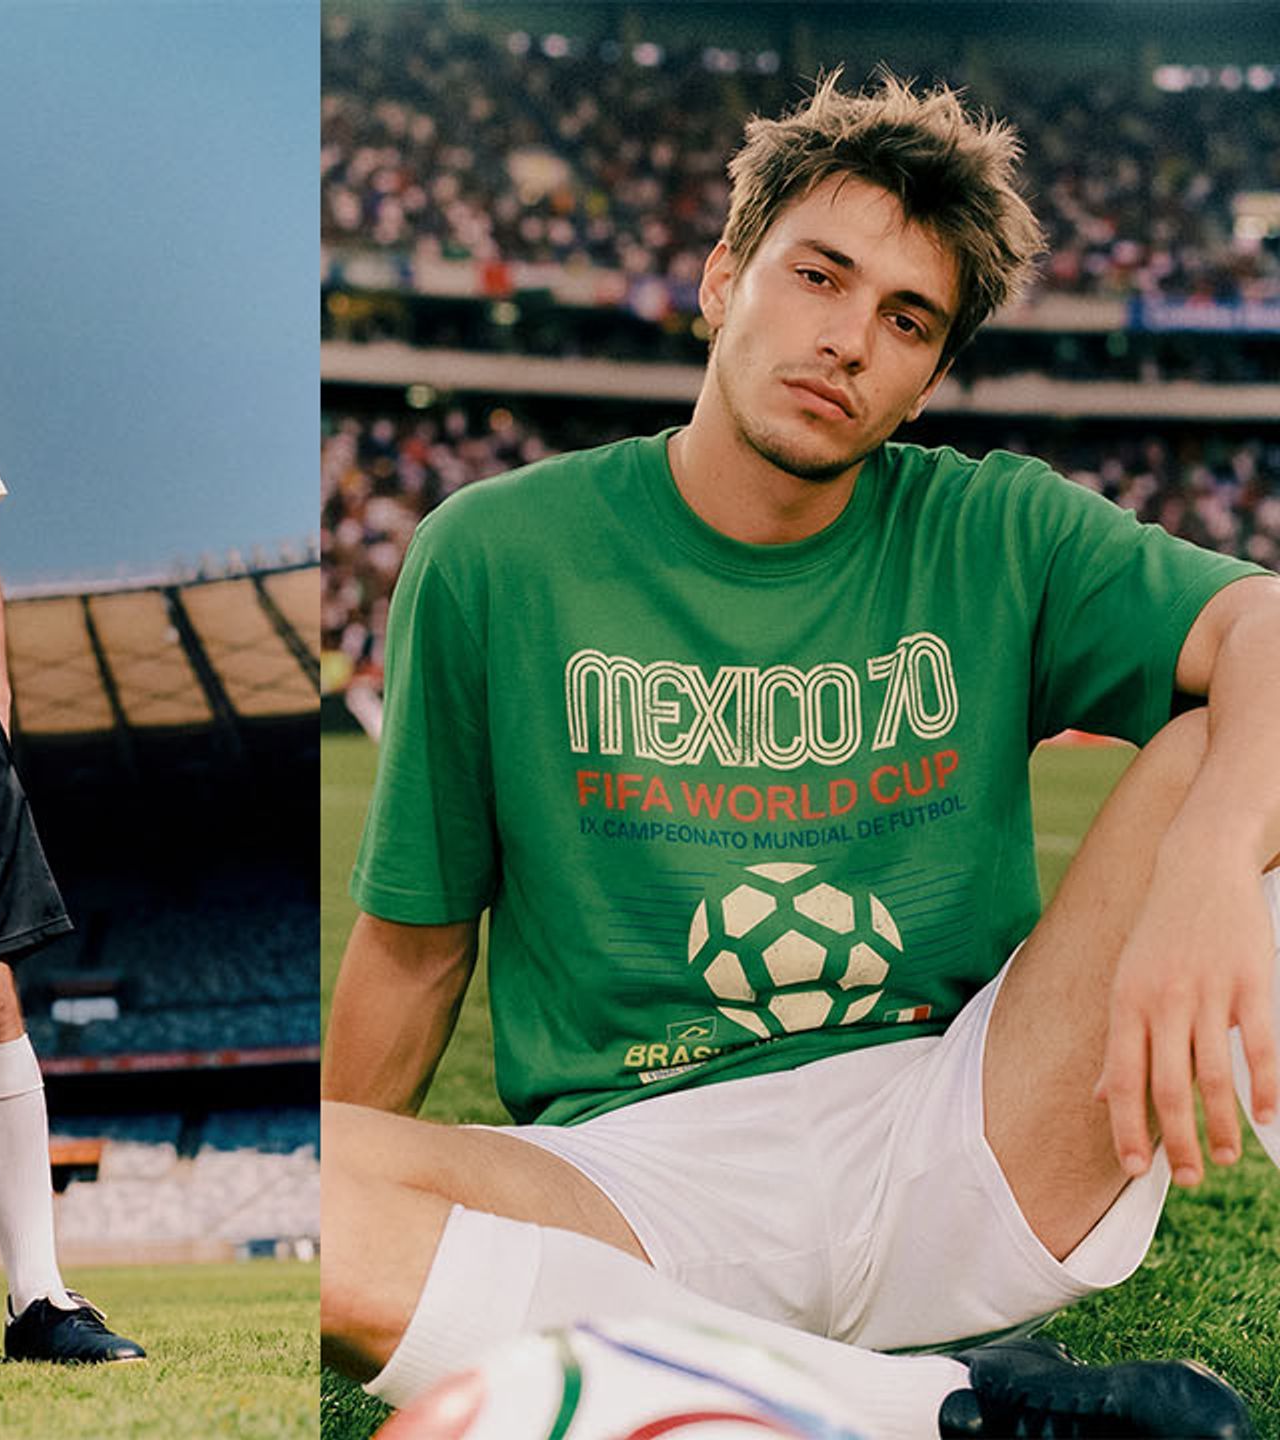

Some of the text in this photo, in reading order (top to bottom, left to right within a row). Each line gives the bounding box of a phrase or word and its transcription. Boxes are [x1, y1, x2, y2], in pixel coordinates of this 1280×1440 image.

[565, 631, 960, 770] MEXICO 70
[576, 749, 960, 823] FIFA WORLD CUP
[579, 794, 968, 850] IX CAMPEONATO MUNDIAL DE FUTBOL
[624, 1043, 721, 1068] BRAS
